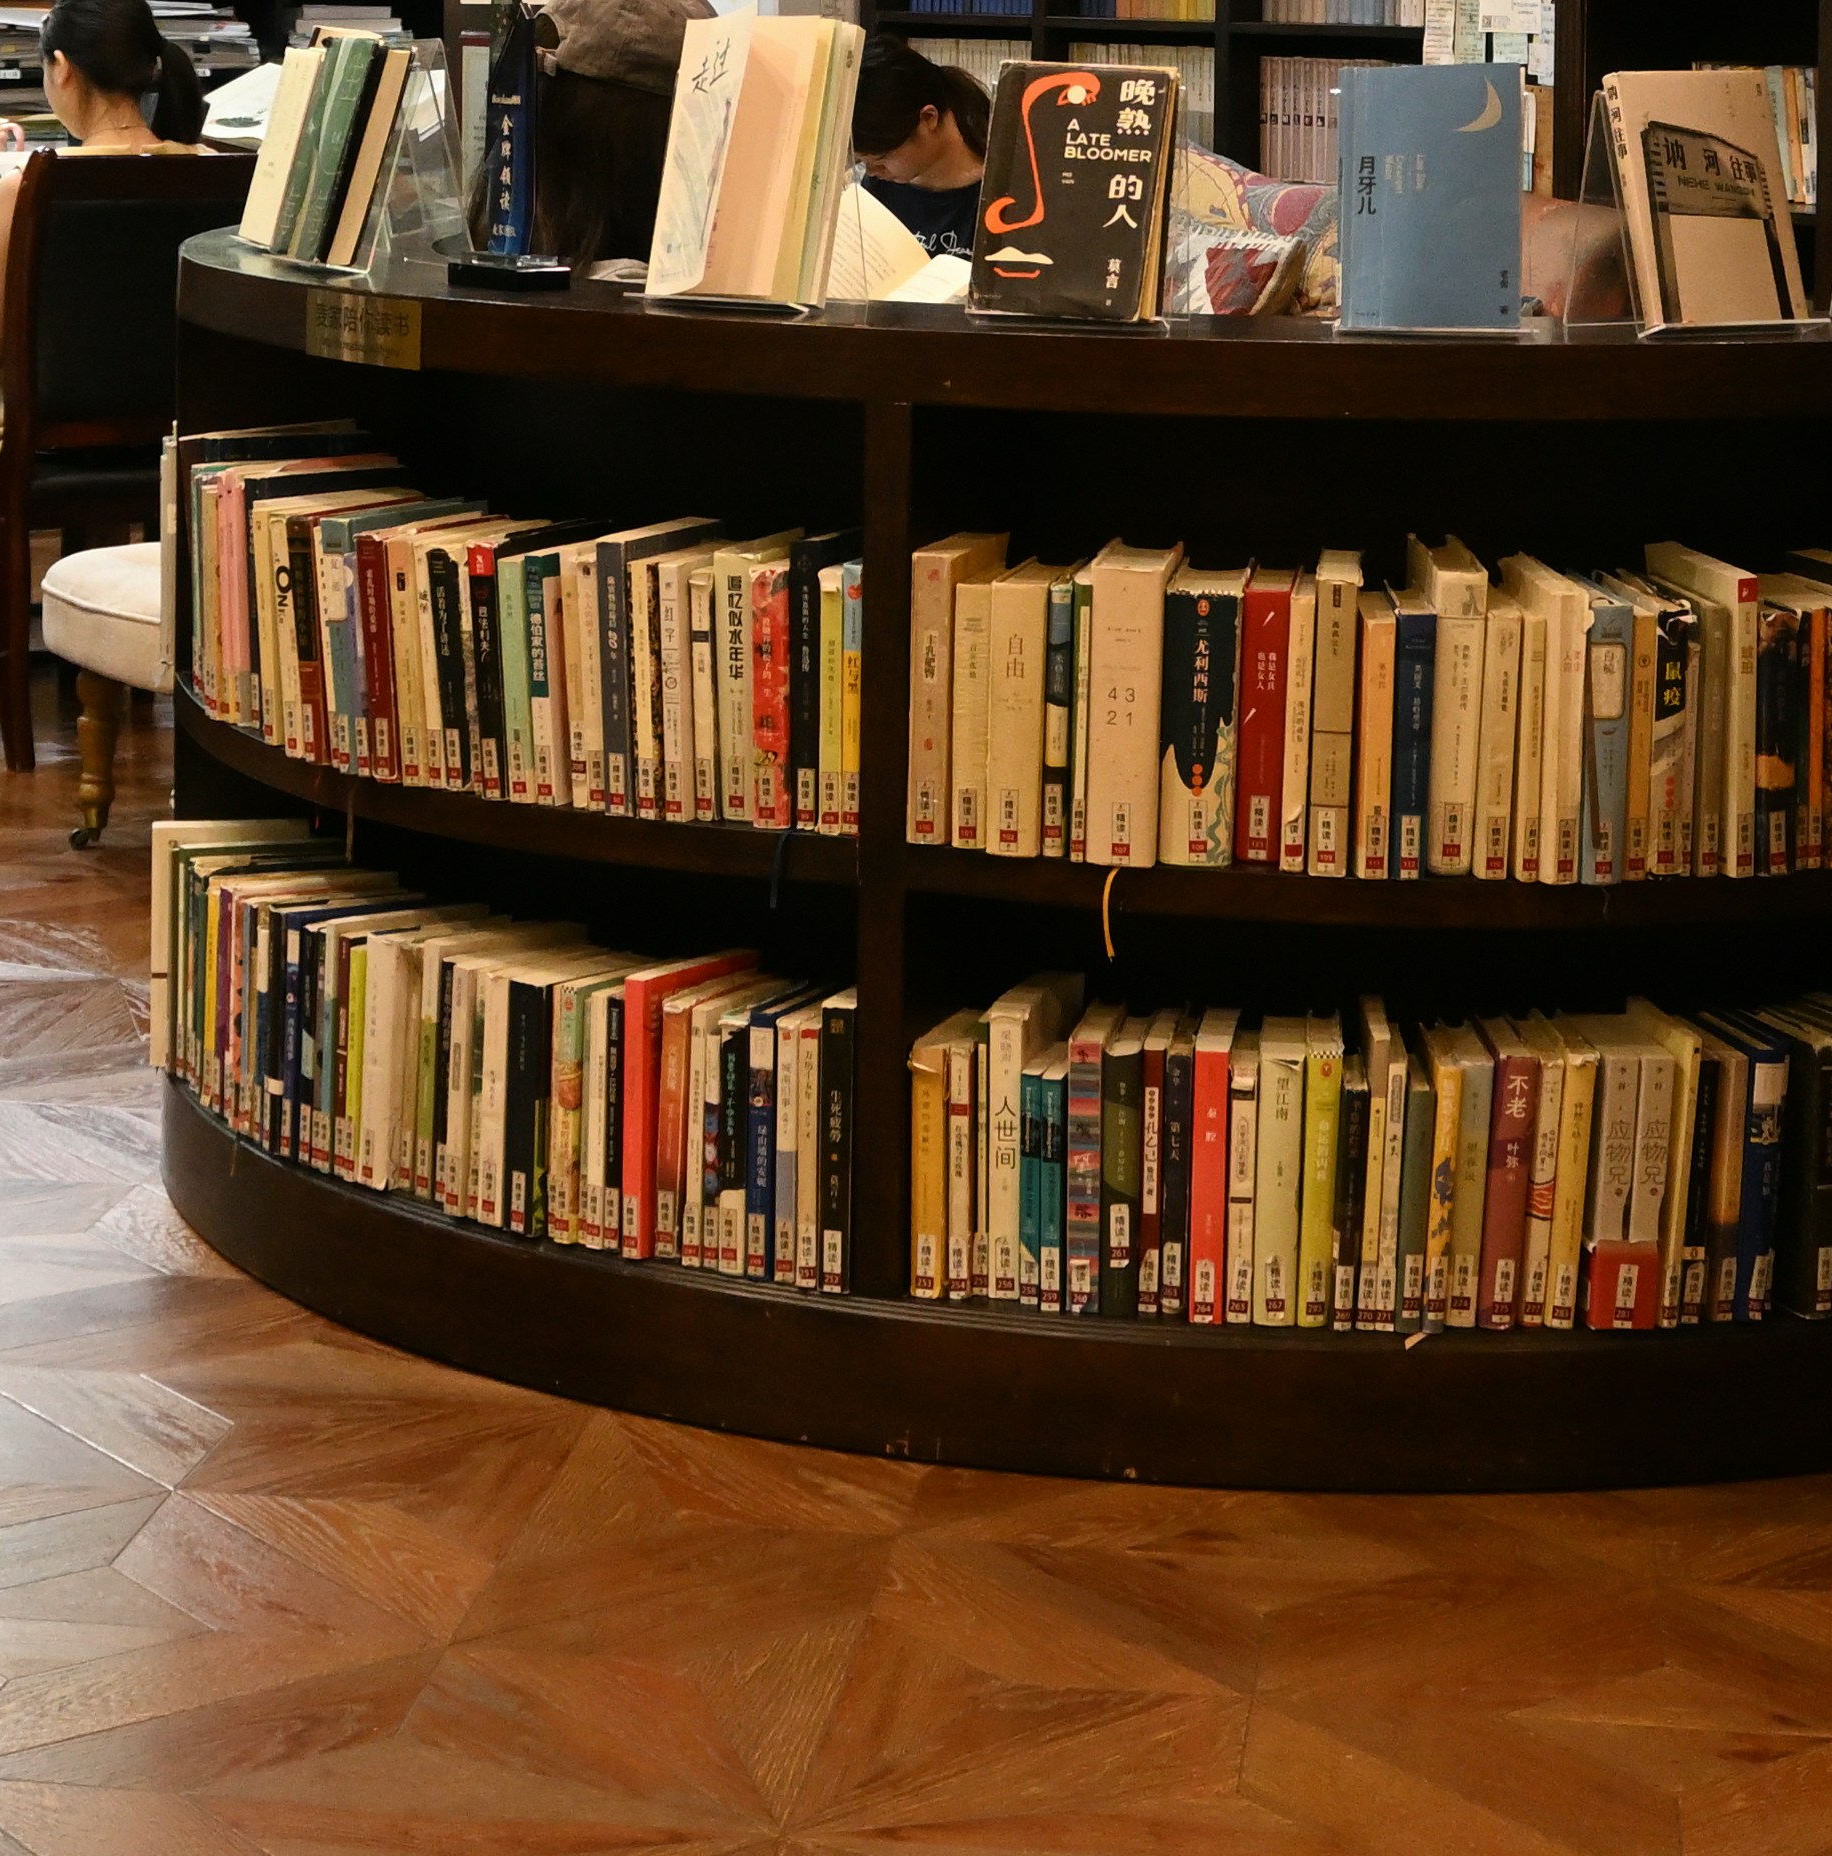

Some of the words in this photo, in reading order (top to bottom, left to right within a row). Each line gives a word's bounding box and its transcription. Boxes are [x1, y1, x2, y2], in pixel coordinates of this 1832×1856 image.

[1067, 118, 1081, 132] A
[1116, 78, 1157, 136] 晚熟
[1064, 146, 1152, 163] BLOOMER
[1065, 132, 1111, 147] LATE
[1102, 173, 1145, 230] 的人
[1357, 155, 1377, 216] 月牙儿
[1105, 257, 1122, 290] 莫言
[529, 612, 546, 682] 德伯家的苔丝
[663, 606, 674, 644] 红字
[727, 575, 744, 680] 追忆似水年华
[847, 655, 860, 695] 红与黑
[1006, 633, 1025, 679] 自由
[1192, 638, 1210, 704] 尤利西斯
[1107, 687, 1118, 703] 4
[1124, 687, 1136, 703] 3
[1663, 660, 1682, 706] 鼠疫
[1106, 711, 1117, 726] 2
[829, 1089, 842, 1144] 生死疲劳
[1275, 1076, 1290, 1122] 望江南
[1505, 1075, 1529, 1119] 不老
[994, 1096, 1018, 1170] 人世间
[1170, 1121, 1181, 1161] 第七天
[1505, 1141, 1520, 1169] 叶弥
[1605, 1122, 1632, 1186] 应物兄
[1640, 1121, 1668, 1186] 应物兄
[1110, 1247, 1126, 1258] 261
